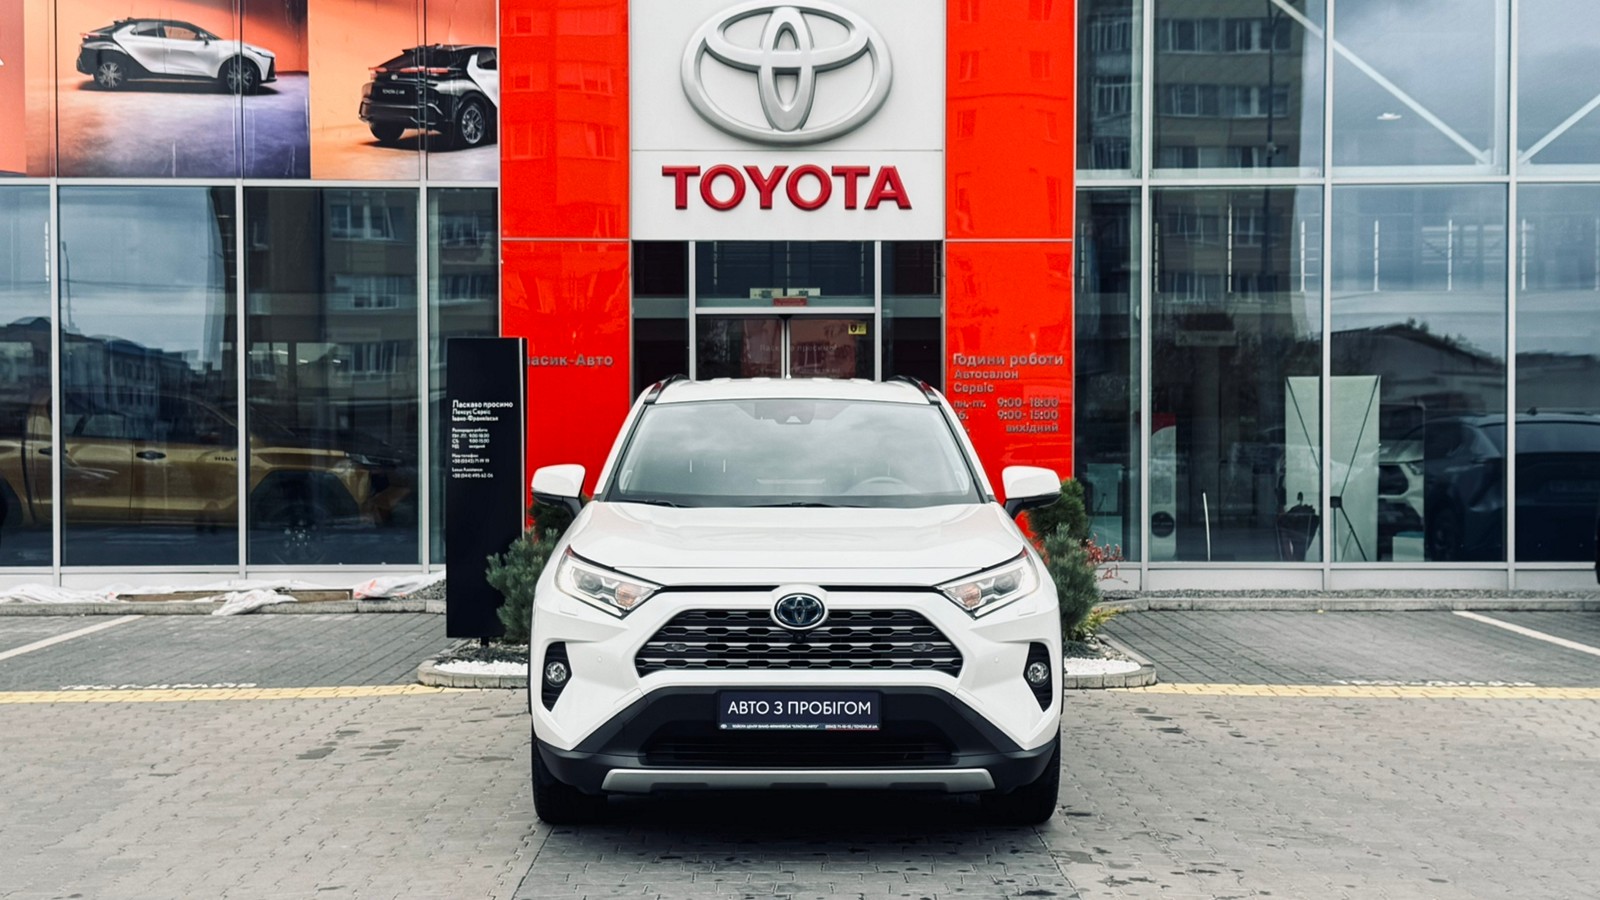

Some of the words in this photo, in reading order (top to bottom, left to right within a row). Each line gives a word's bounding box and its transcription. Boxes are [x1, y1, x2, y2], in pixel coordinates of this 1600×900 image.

[662, 164, 912, 211] TOYOTA
[527, 353, 614, 367] асик-Авто
[952, 353, 1005, 367] Години
[1009, 352, 1064, 367] роботи
[954, 370, 1019, 379] Автосалон
[953, 382, 994, 394] Сервіс
[452, 399, 482, 408] Ласкаво
[1029, 410, 1059, 420] 15:00
[1006, 423, 1059, 433] вихідний
[727, 701, 770, 715] АВТО
[787, 701, 872, 715] ПРОБІГОМ
